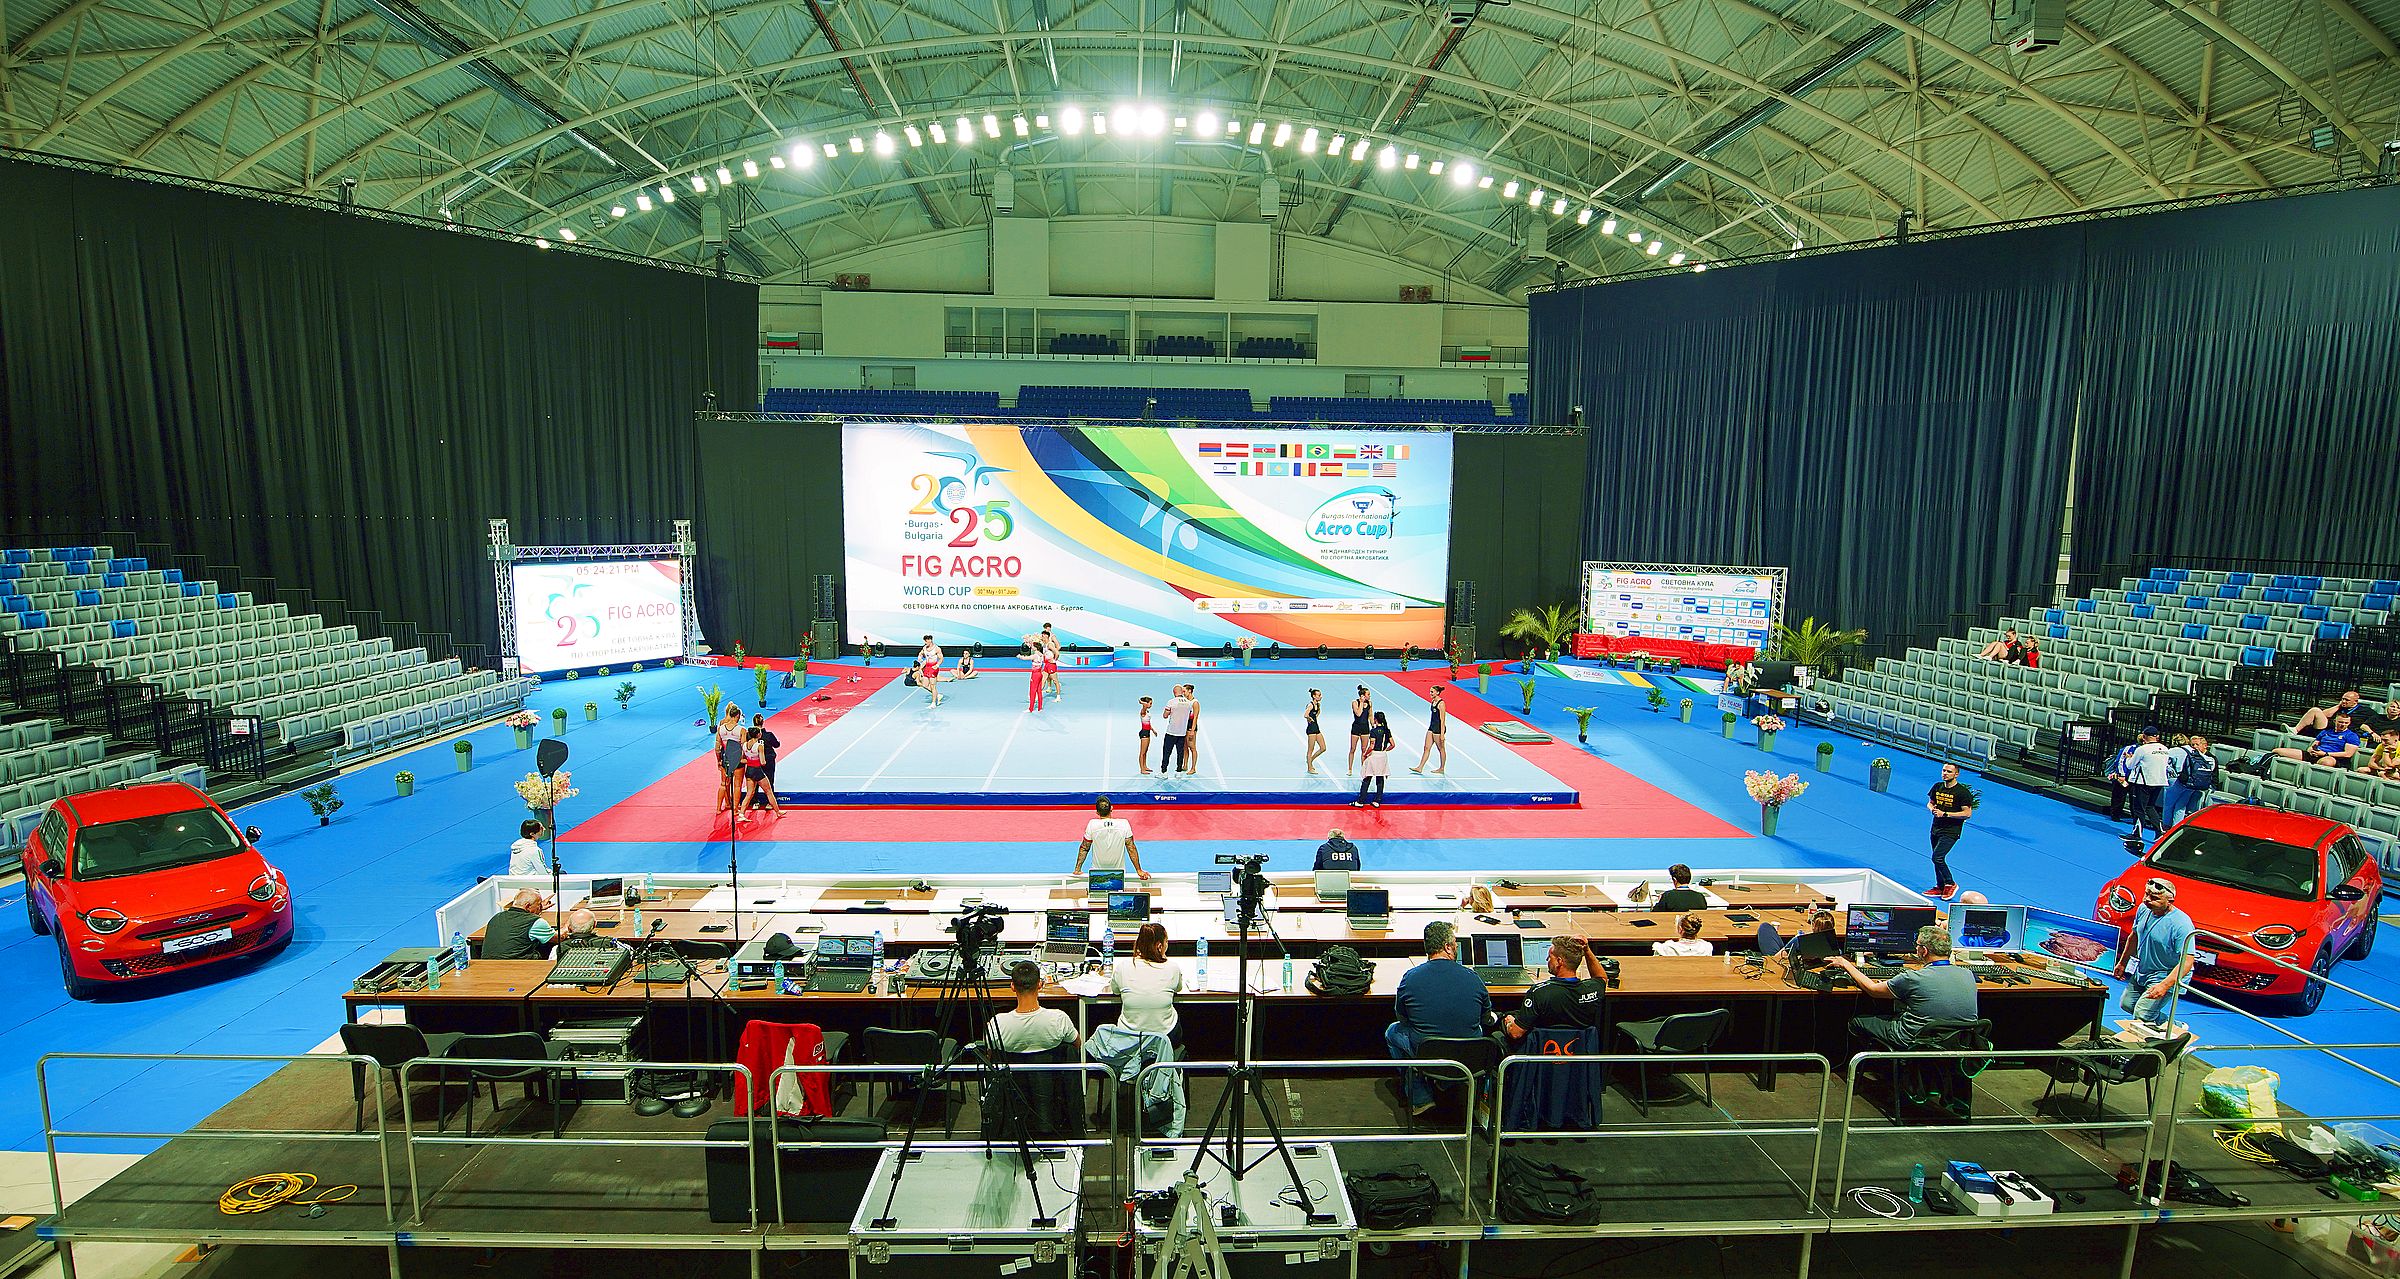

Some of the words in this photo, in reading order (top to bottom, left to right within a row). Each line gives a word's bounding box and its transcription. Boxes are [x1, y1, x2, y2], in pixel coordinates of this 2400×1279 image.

[1315, 521, 1352, 535] Acro
[1356, 521, 1388, 539] Cup
[904, 531, 943, 541] Bulgaria
[576, 565, 621, 576] 05:24:21
[624, 564, 640, 574] PM
[902, 555, 942, 577] FIG
[950, 555, 1022, 578] ACRO
[1661, 578, 1695, 586] СВЕТОВНА
[903, 586, 945, 596] WORLD
[948, 586, 972, 597] CUP
[608, 605, 632, 621] FIG
[636, 602, 676, 619] ACRO
[1331, 852, 1353, 862] GBR
[1579, 991, 1598, 1001] JURY
